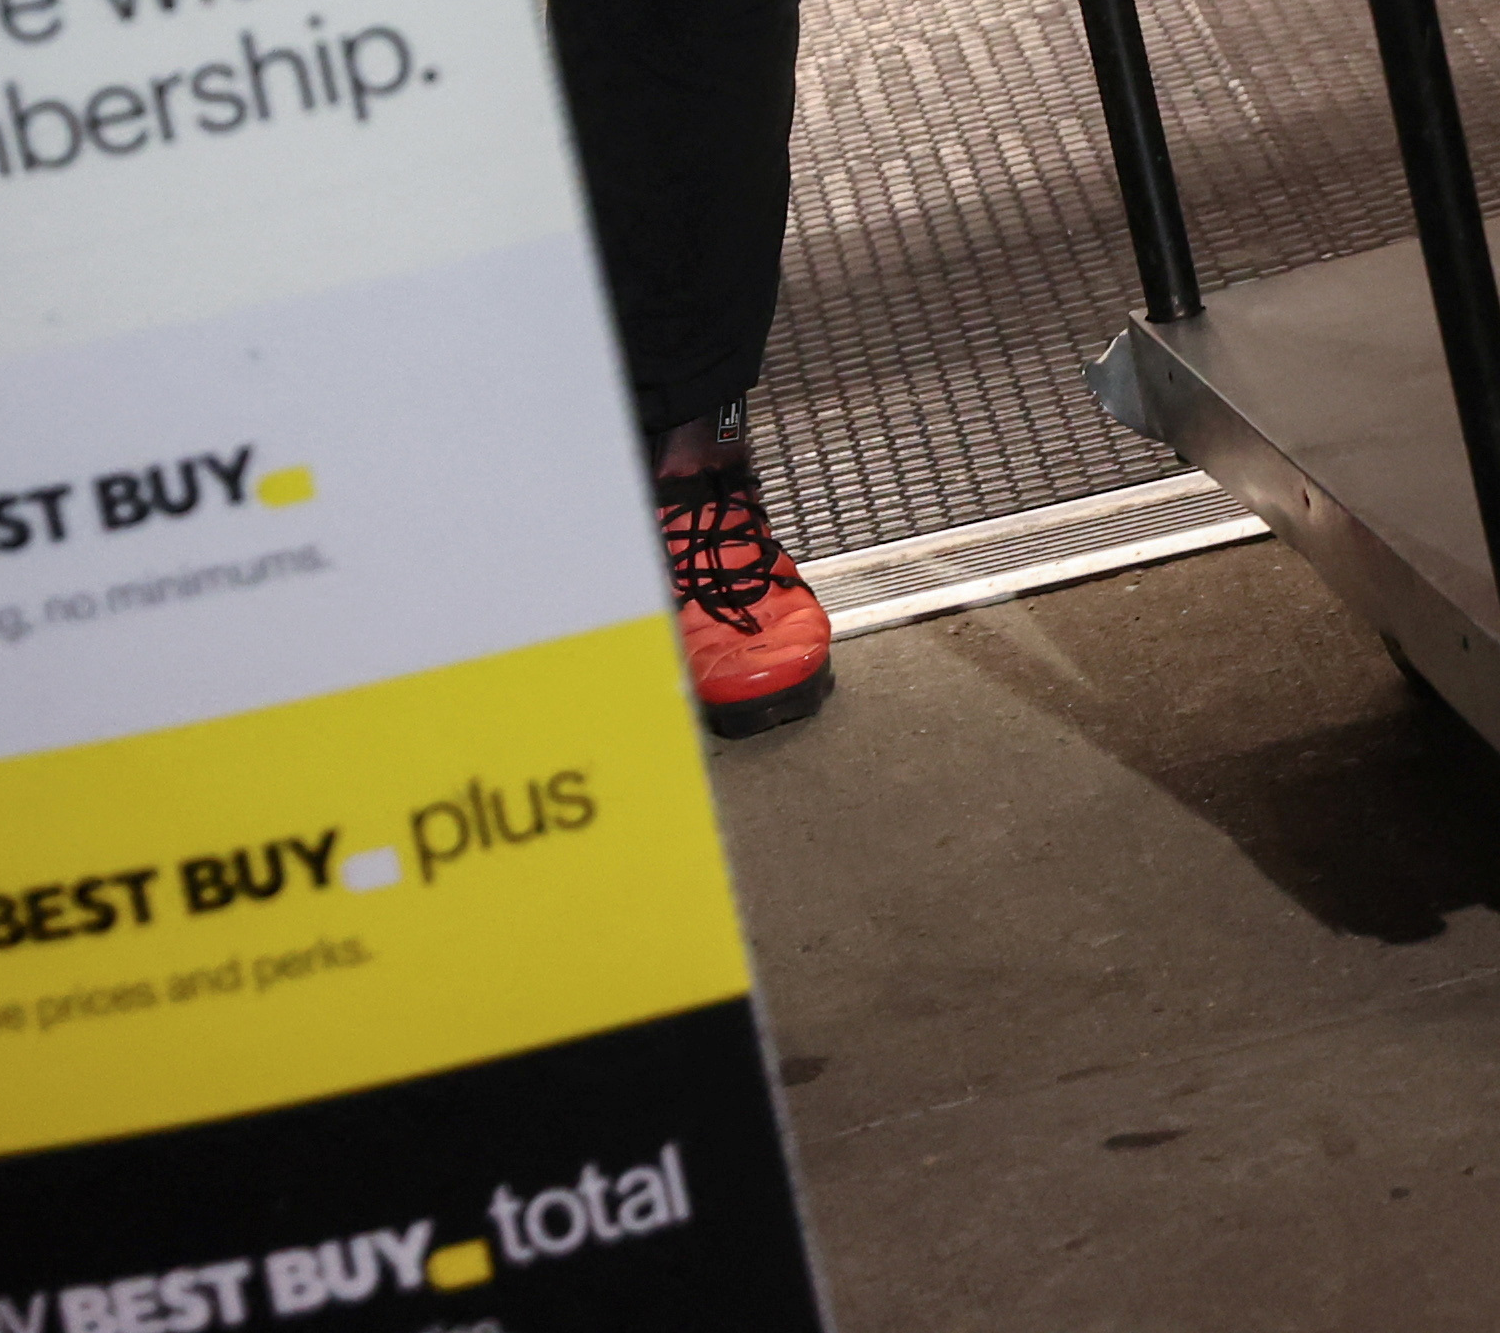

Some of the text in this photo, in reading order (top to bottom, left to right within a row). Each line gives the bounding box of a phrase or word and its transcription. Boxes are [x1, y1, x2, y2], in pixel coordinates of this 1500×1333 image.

[92, 444, 261, 532] BUY
[43, 587, 97, 623] no
[104, 539, 332, 615] minimums.
[181, 828, 344, 915] BUY
[409, 764, 598, 884] plus
[34, 975, 159, 1036] prices
[165, 954, 243, 1004] and
[251, 930, 377, 994] perks.
[59, 1262, 250, 1333] BEST
[265, 1221, 435, 1300] BUY
[488, 1143, 693, 1266] total
